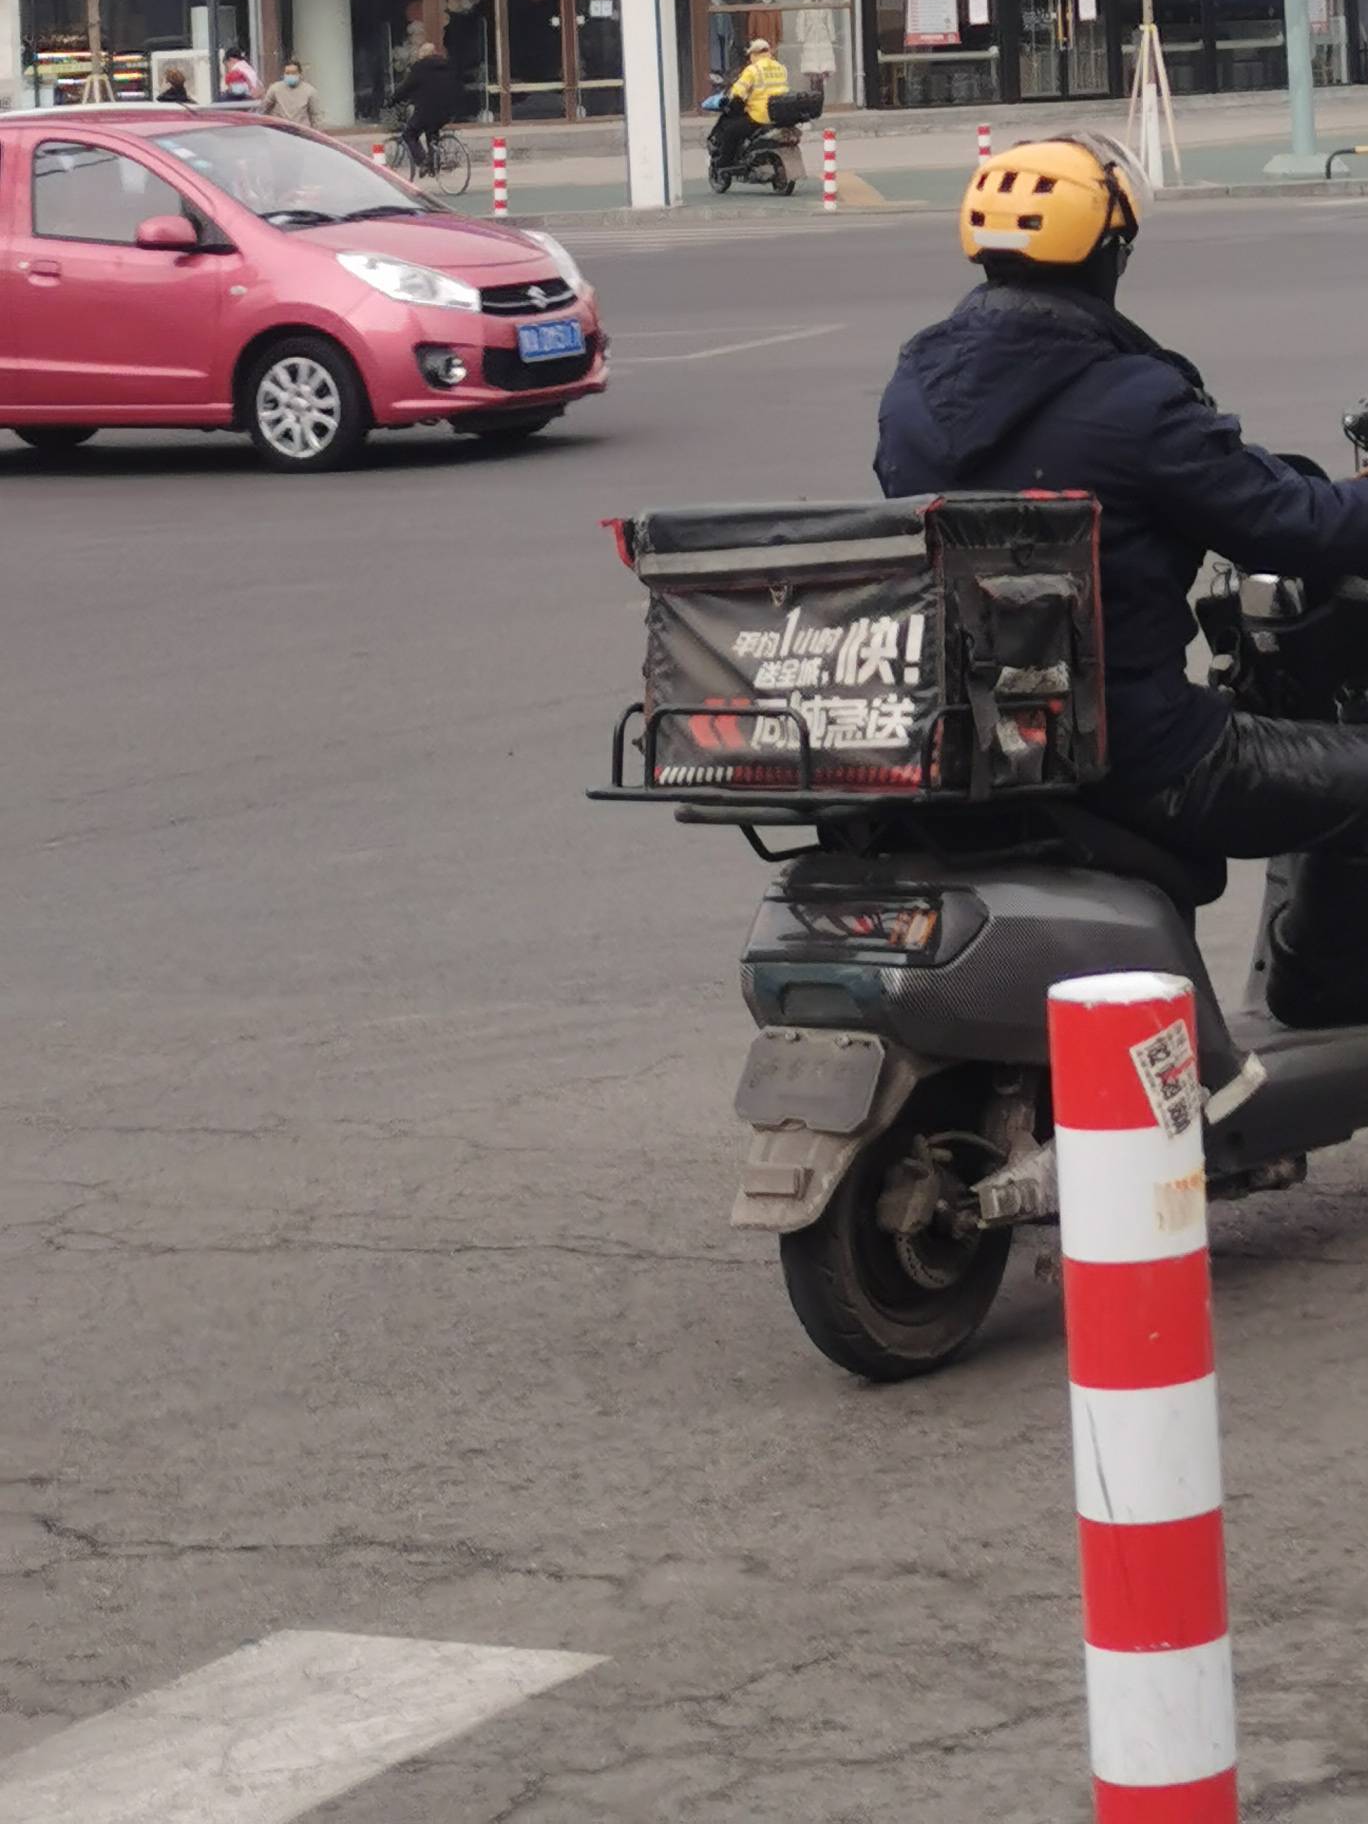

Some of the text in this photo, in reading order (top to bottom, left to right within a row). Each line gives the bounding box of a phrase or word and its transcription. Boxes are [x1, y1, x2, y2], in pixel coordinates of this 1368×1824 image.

[733, 607, 844, 658] 平均1小时
[751, 690, 916, 750] 同城急送
